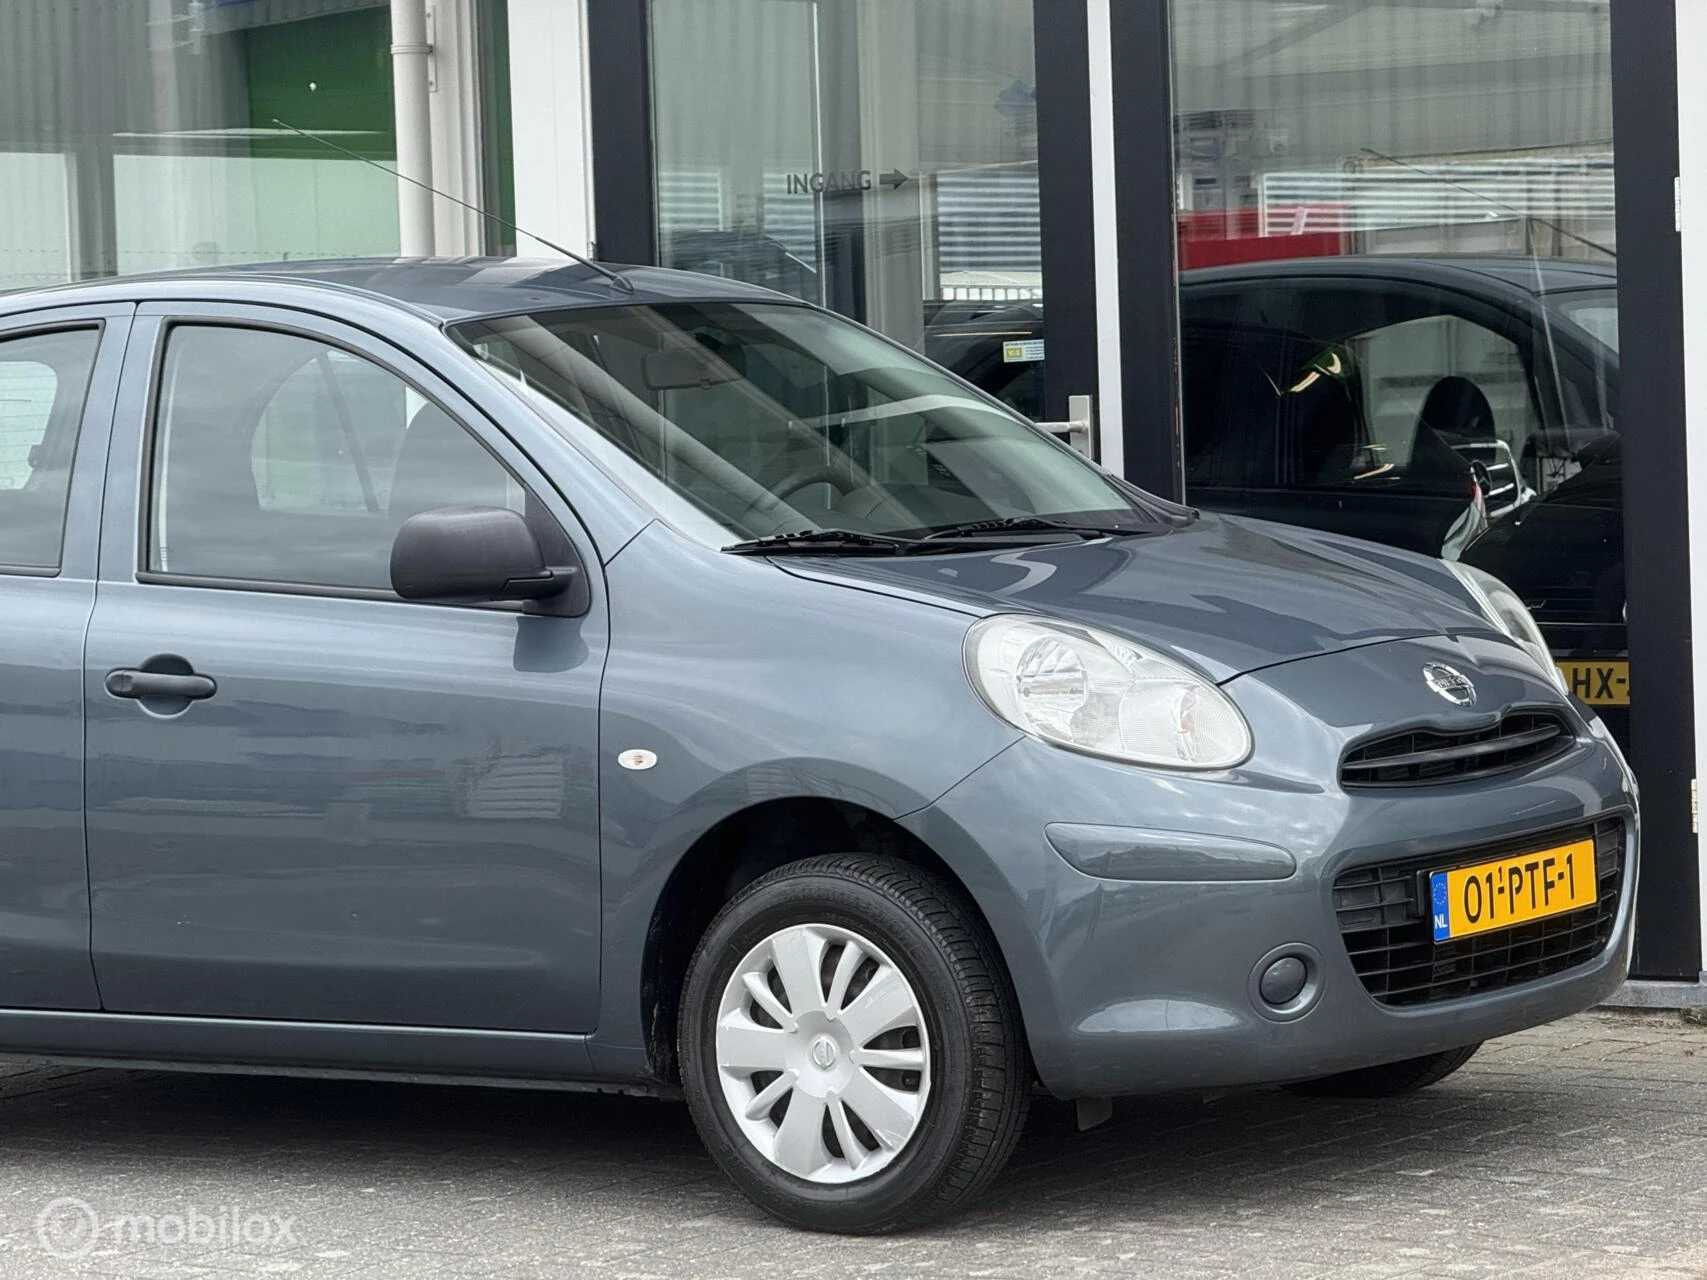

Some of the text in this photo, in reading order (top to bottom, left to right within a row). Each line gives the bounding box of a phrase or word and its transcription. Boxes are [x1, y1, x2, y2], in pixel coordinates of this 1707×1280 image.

[786, 171, 871, 194] INGANG
[1464, 853, 1575, 924] 01-PTF-1
[1434, 913, 1448, 930] NL
